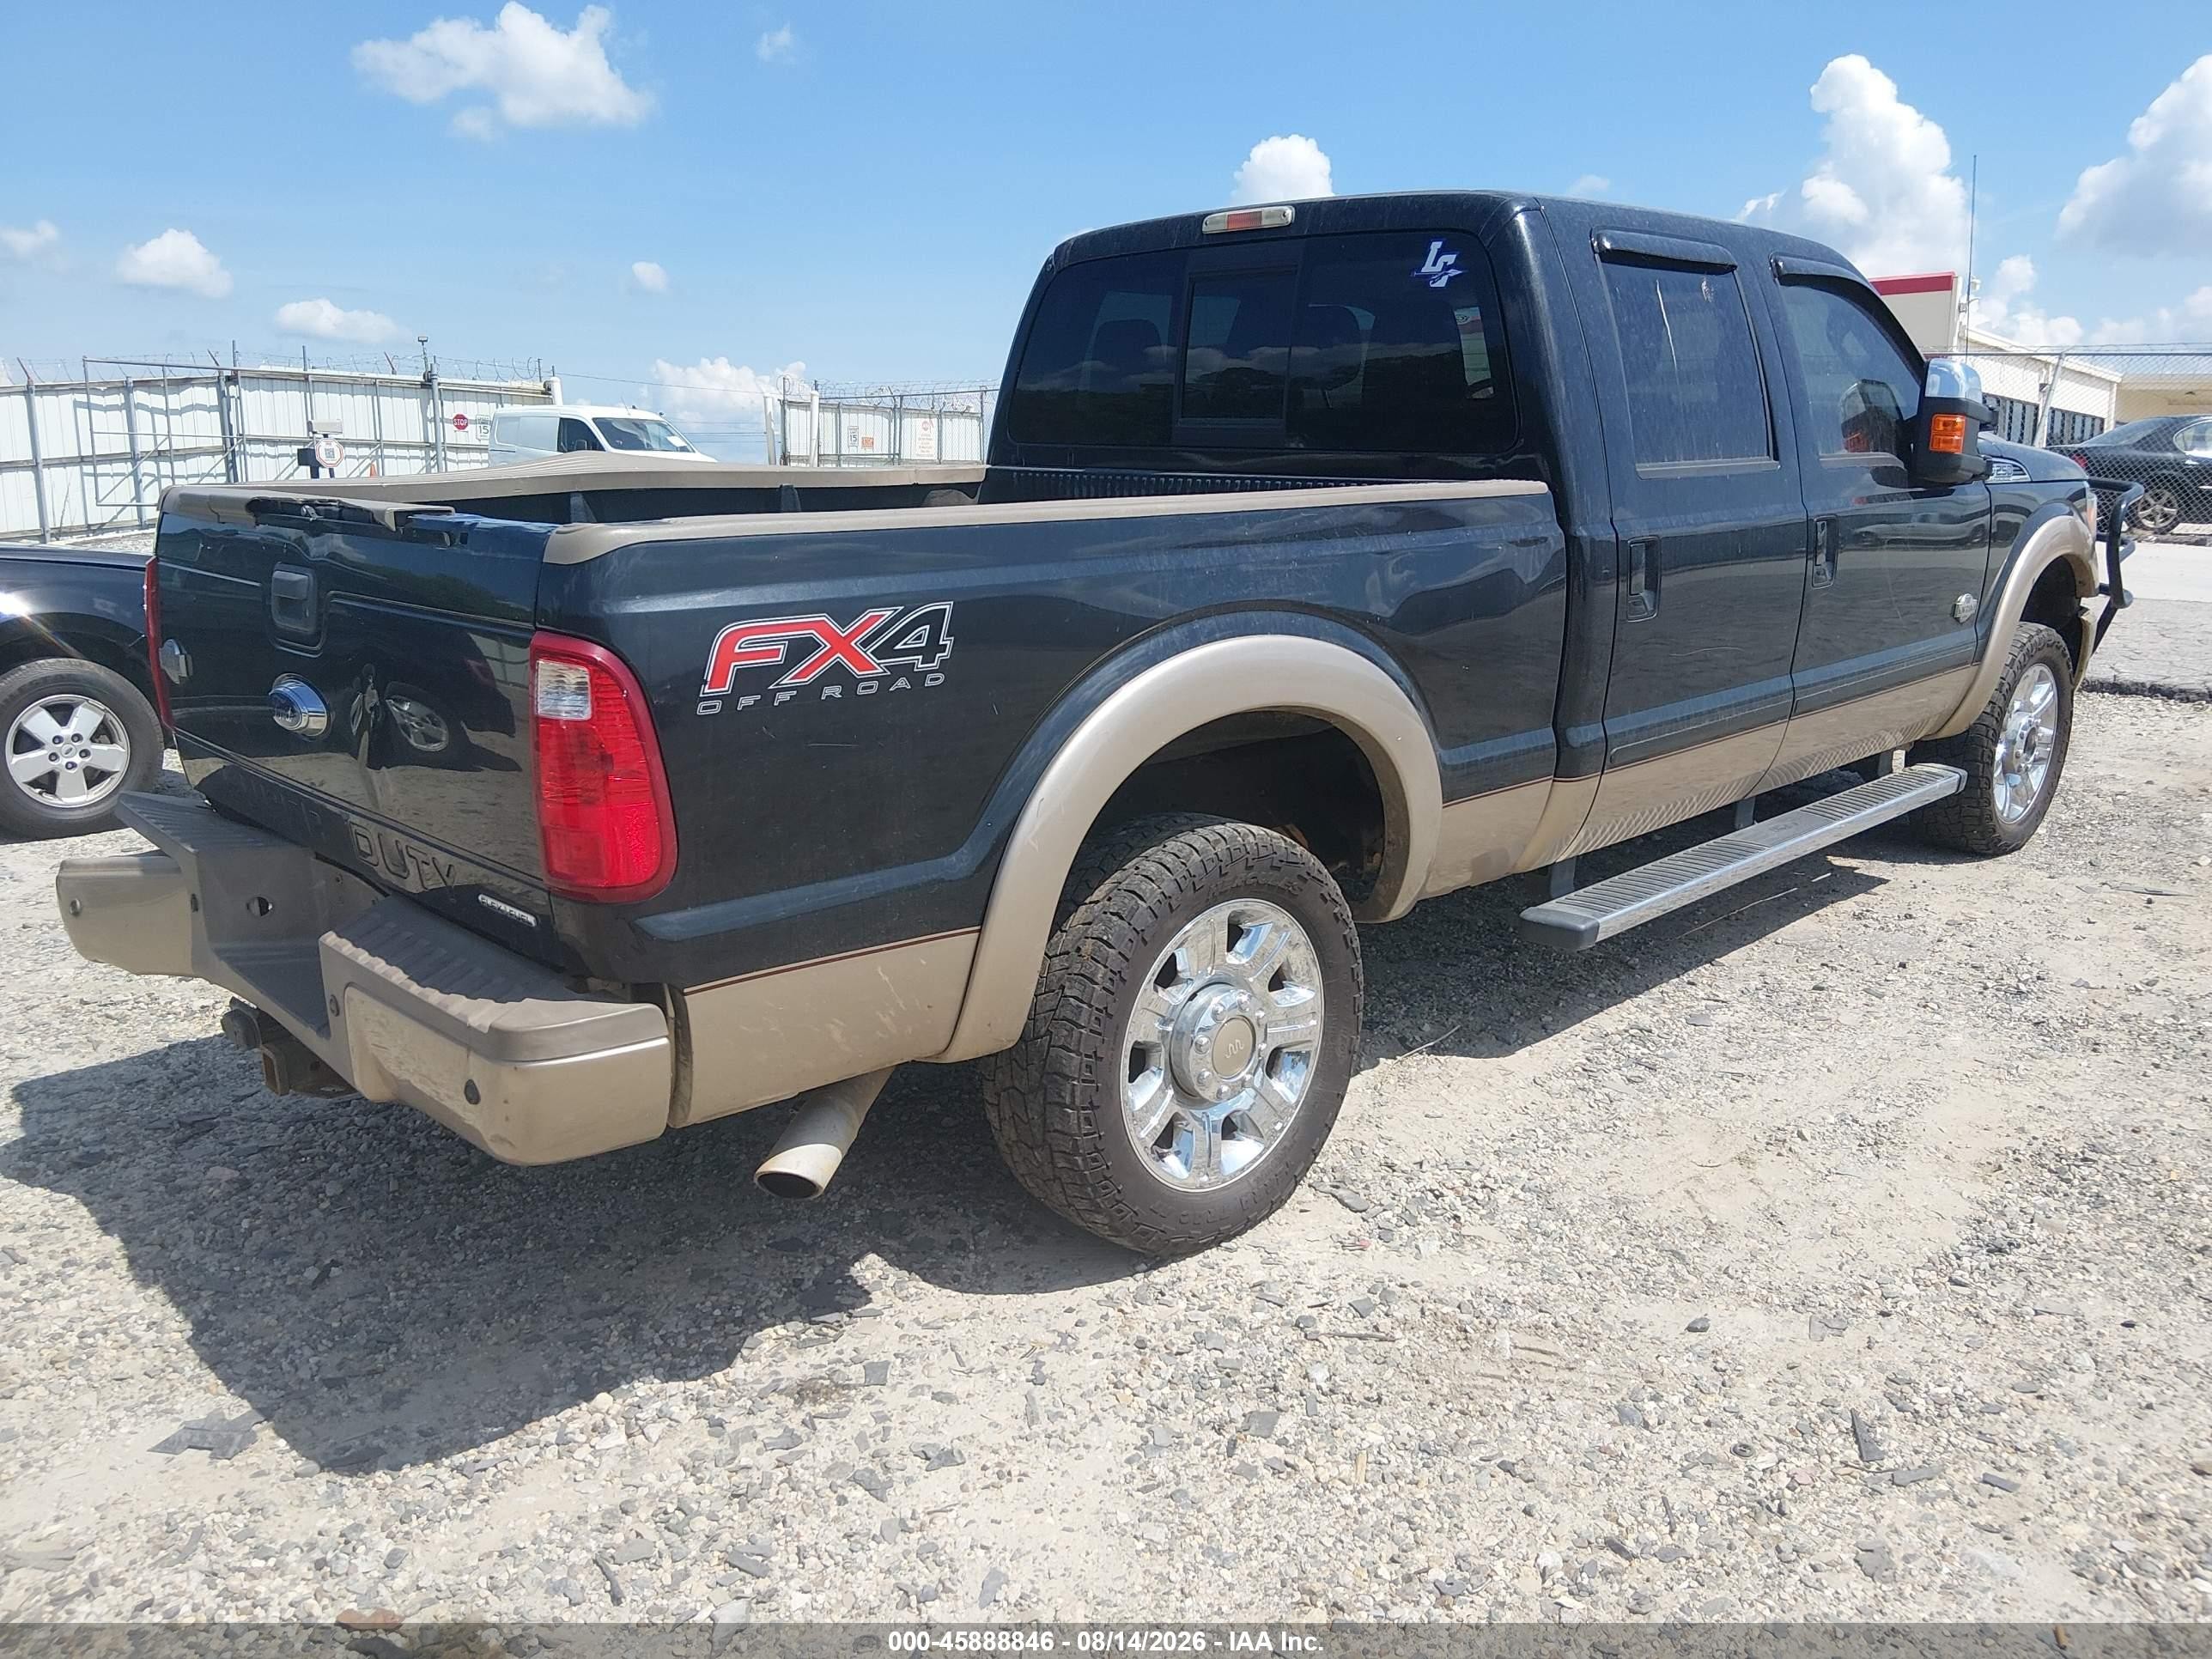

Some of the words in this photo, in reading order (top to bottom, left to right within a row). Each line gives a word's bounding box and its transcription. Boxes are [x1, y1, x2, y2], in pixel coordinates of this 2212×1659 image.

[479, 425, 489, 434] 15
[849, 434, 858, 442] 15
[700, 601, 954, 696] FX4
[696, 690, 797, 715] OFF
[821, 672, 945, 700] ROAD
[348, 821, 459, 896] DUTY
